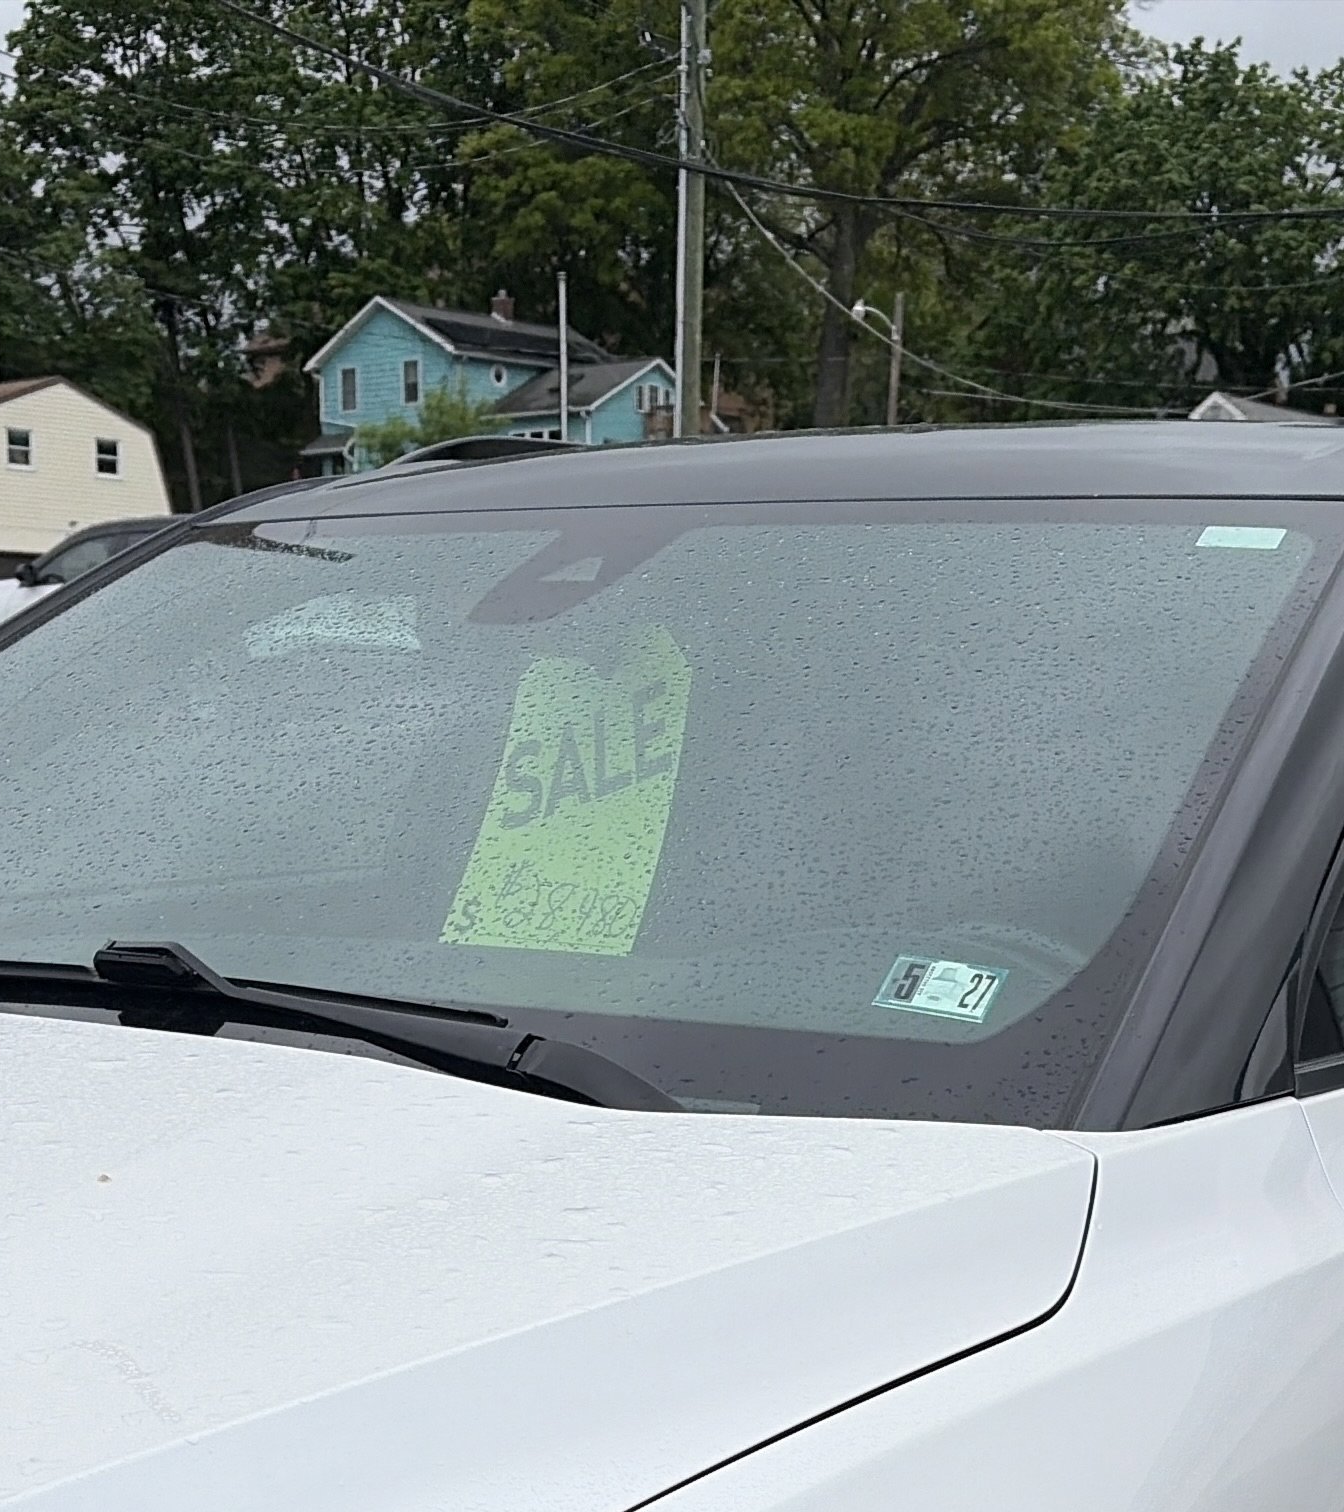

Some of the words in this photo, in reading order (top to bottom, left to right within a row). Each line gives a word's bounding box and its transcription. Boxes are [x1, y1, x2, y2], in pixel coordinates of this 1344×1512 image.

[499, 679, 673, 830] SALE
[894, 963, 926, 1000] 5
[957, 973, 997, 1011] 27
